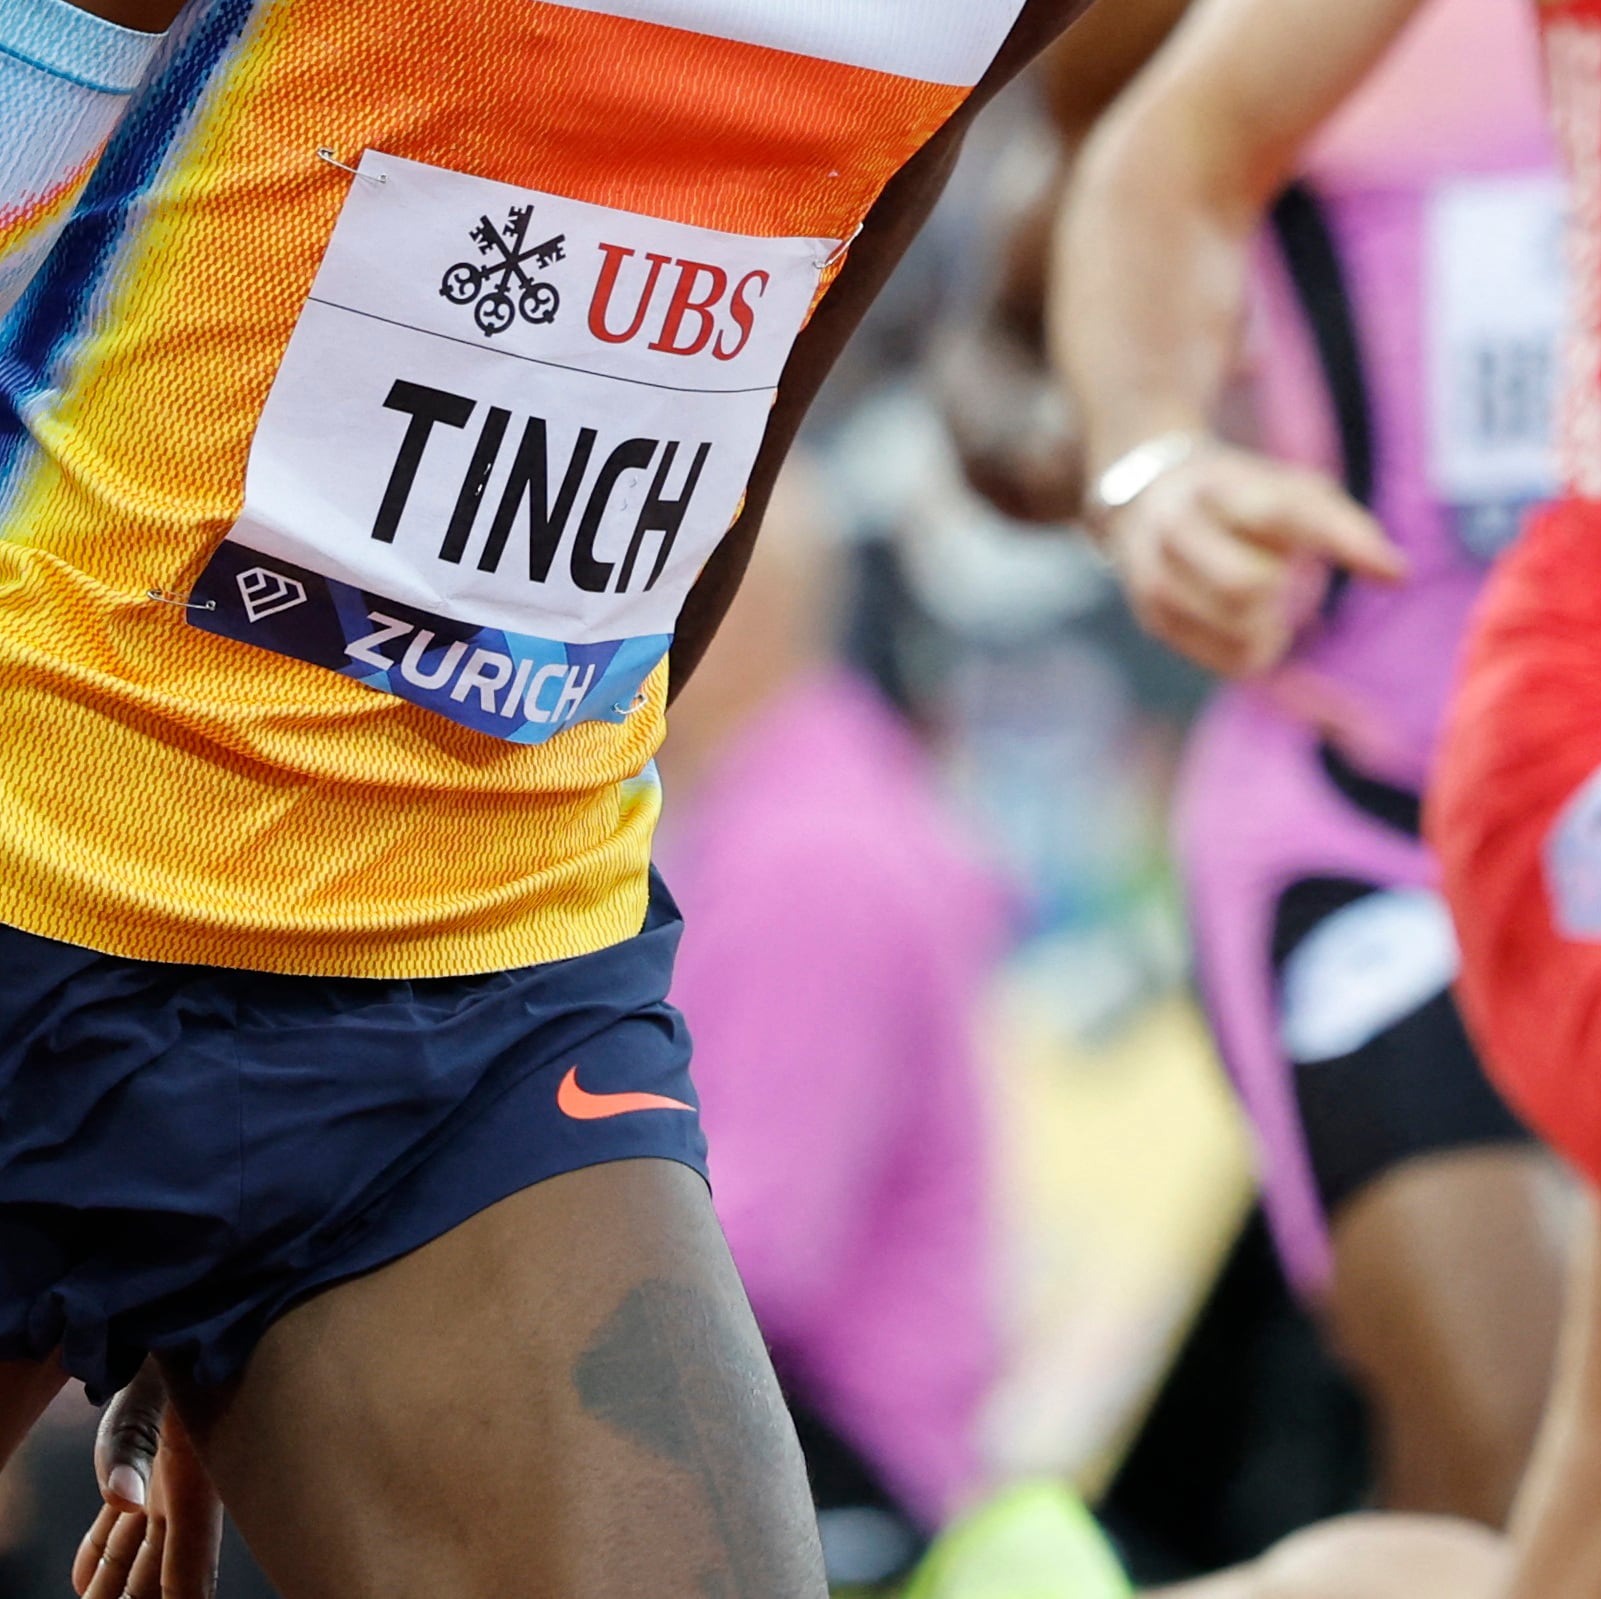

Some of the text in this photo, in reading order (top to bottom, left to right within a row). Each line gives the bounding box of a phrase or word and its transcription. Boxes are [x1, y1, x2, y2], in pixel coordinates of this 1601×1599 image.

[586, 242, 770, 362] UBS
[370, 378, 712, 594] TINCH
[344, 611, 596, 724] ZURICH
